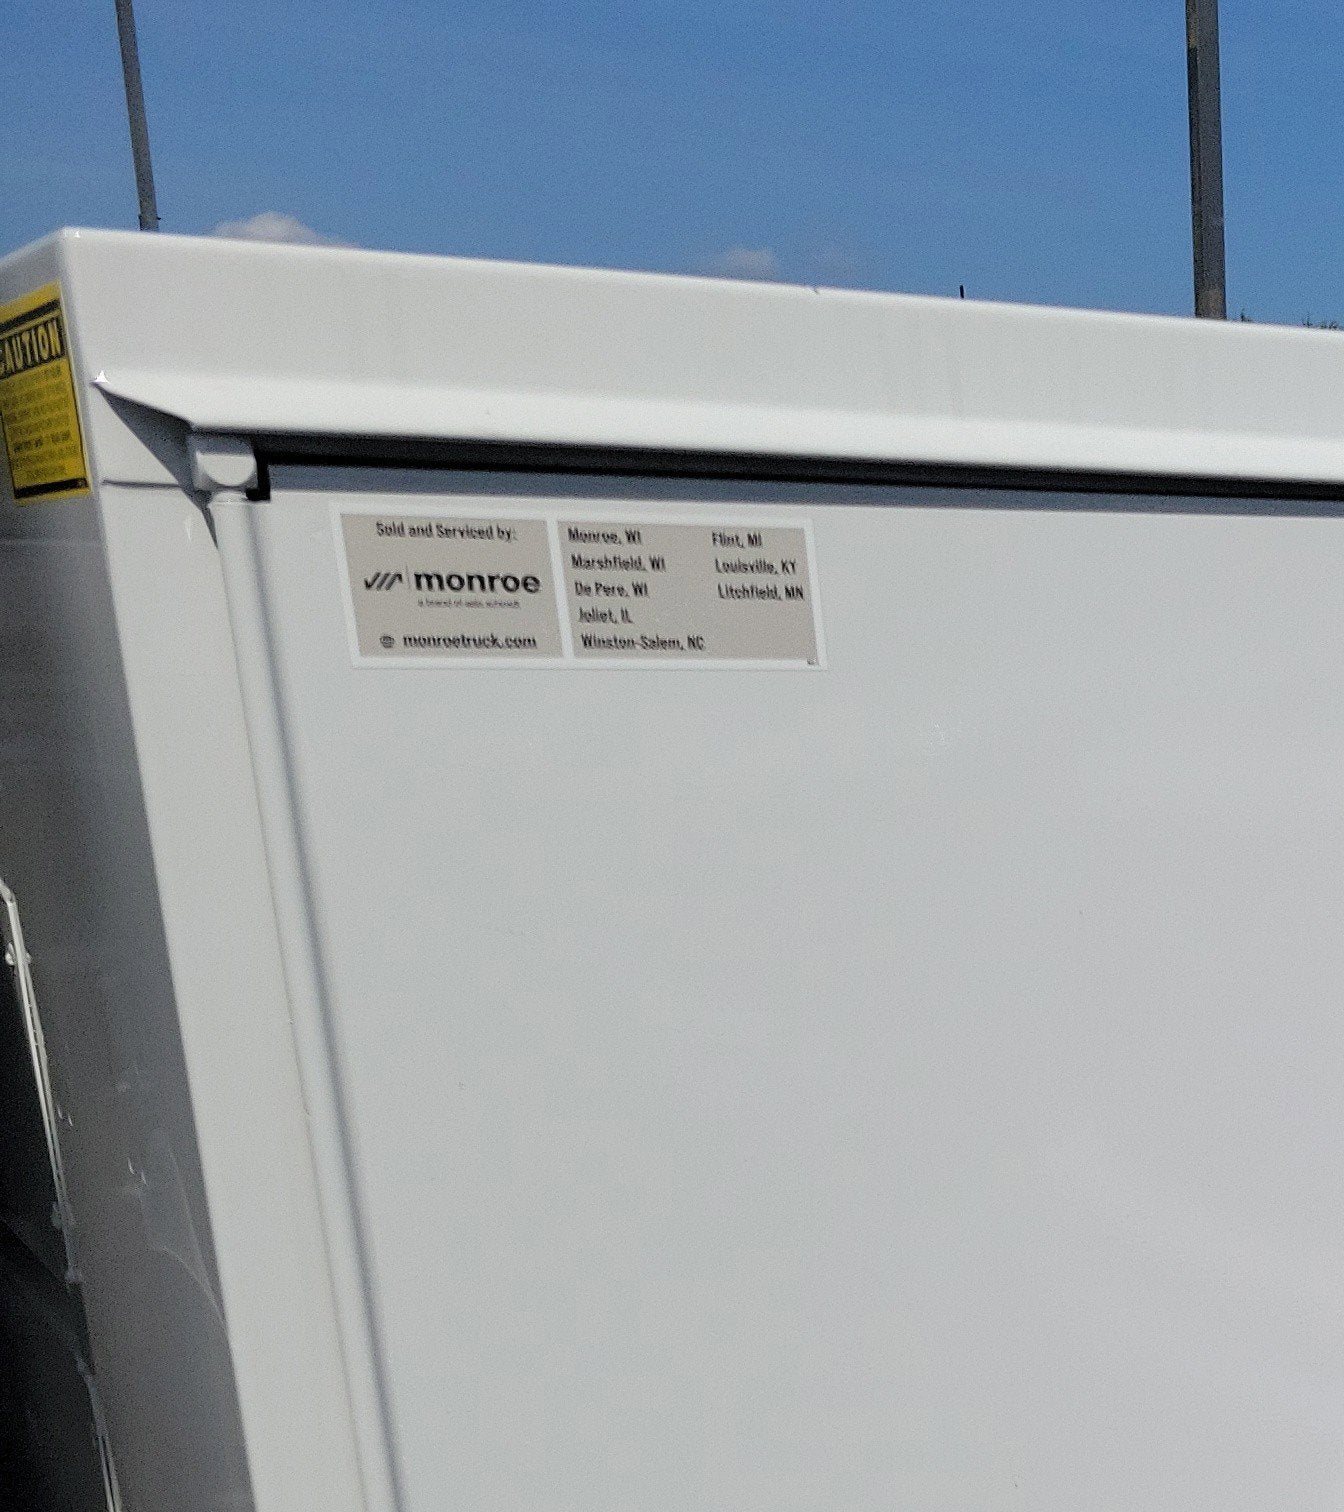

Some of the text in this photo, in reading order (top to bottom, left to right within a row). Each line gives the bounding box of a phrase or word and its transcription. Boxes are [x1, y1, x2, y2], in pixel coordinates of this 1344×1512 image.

[376, 521, 405, 538] Sold
[409, 522, 433, 539] and
[435, 523, 494, 540] Serviced
[568, 527, 642, 545] Monroe, WI
[649, 554, 666, 572] WI
[715, 558, 798, 575] Louisville, KY
[414, 573, 541, 593] monroe
[575, 581, 592, 597] De
[632, 581, 649, 598] WI
[717, 583, 805, 601] Litchfield, MN
[579, 607, 634, 624] Joliet, IL
[403, 634, 537, 649] monroetruck.com
[687, 634, 705, 652] NC
